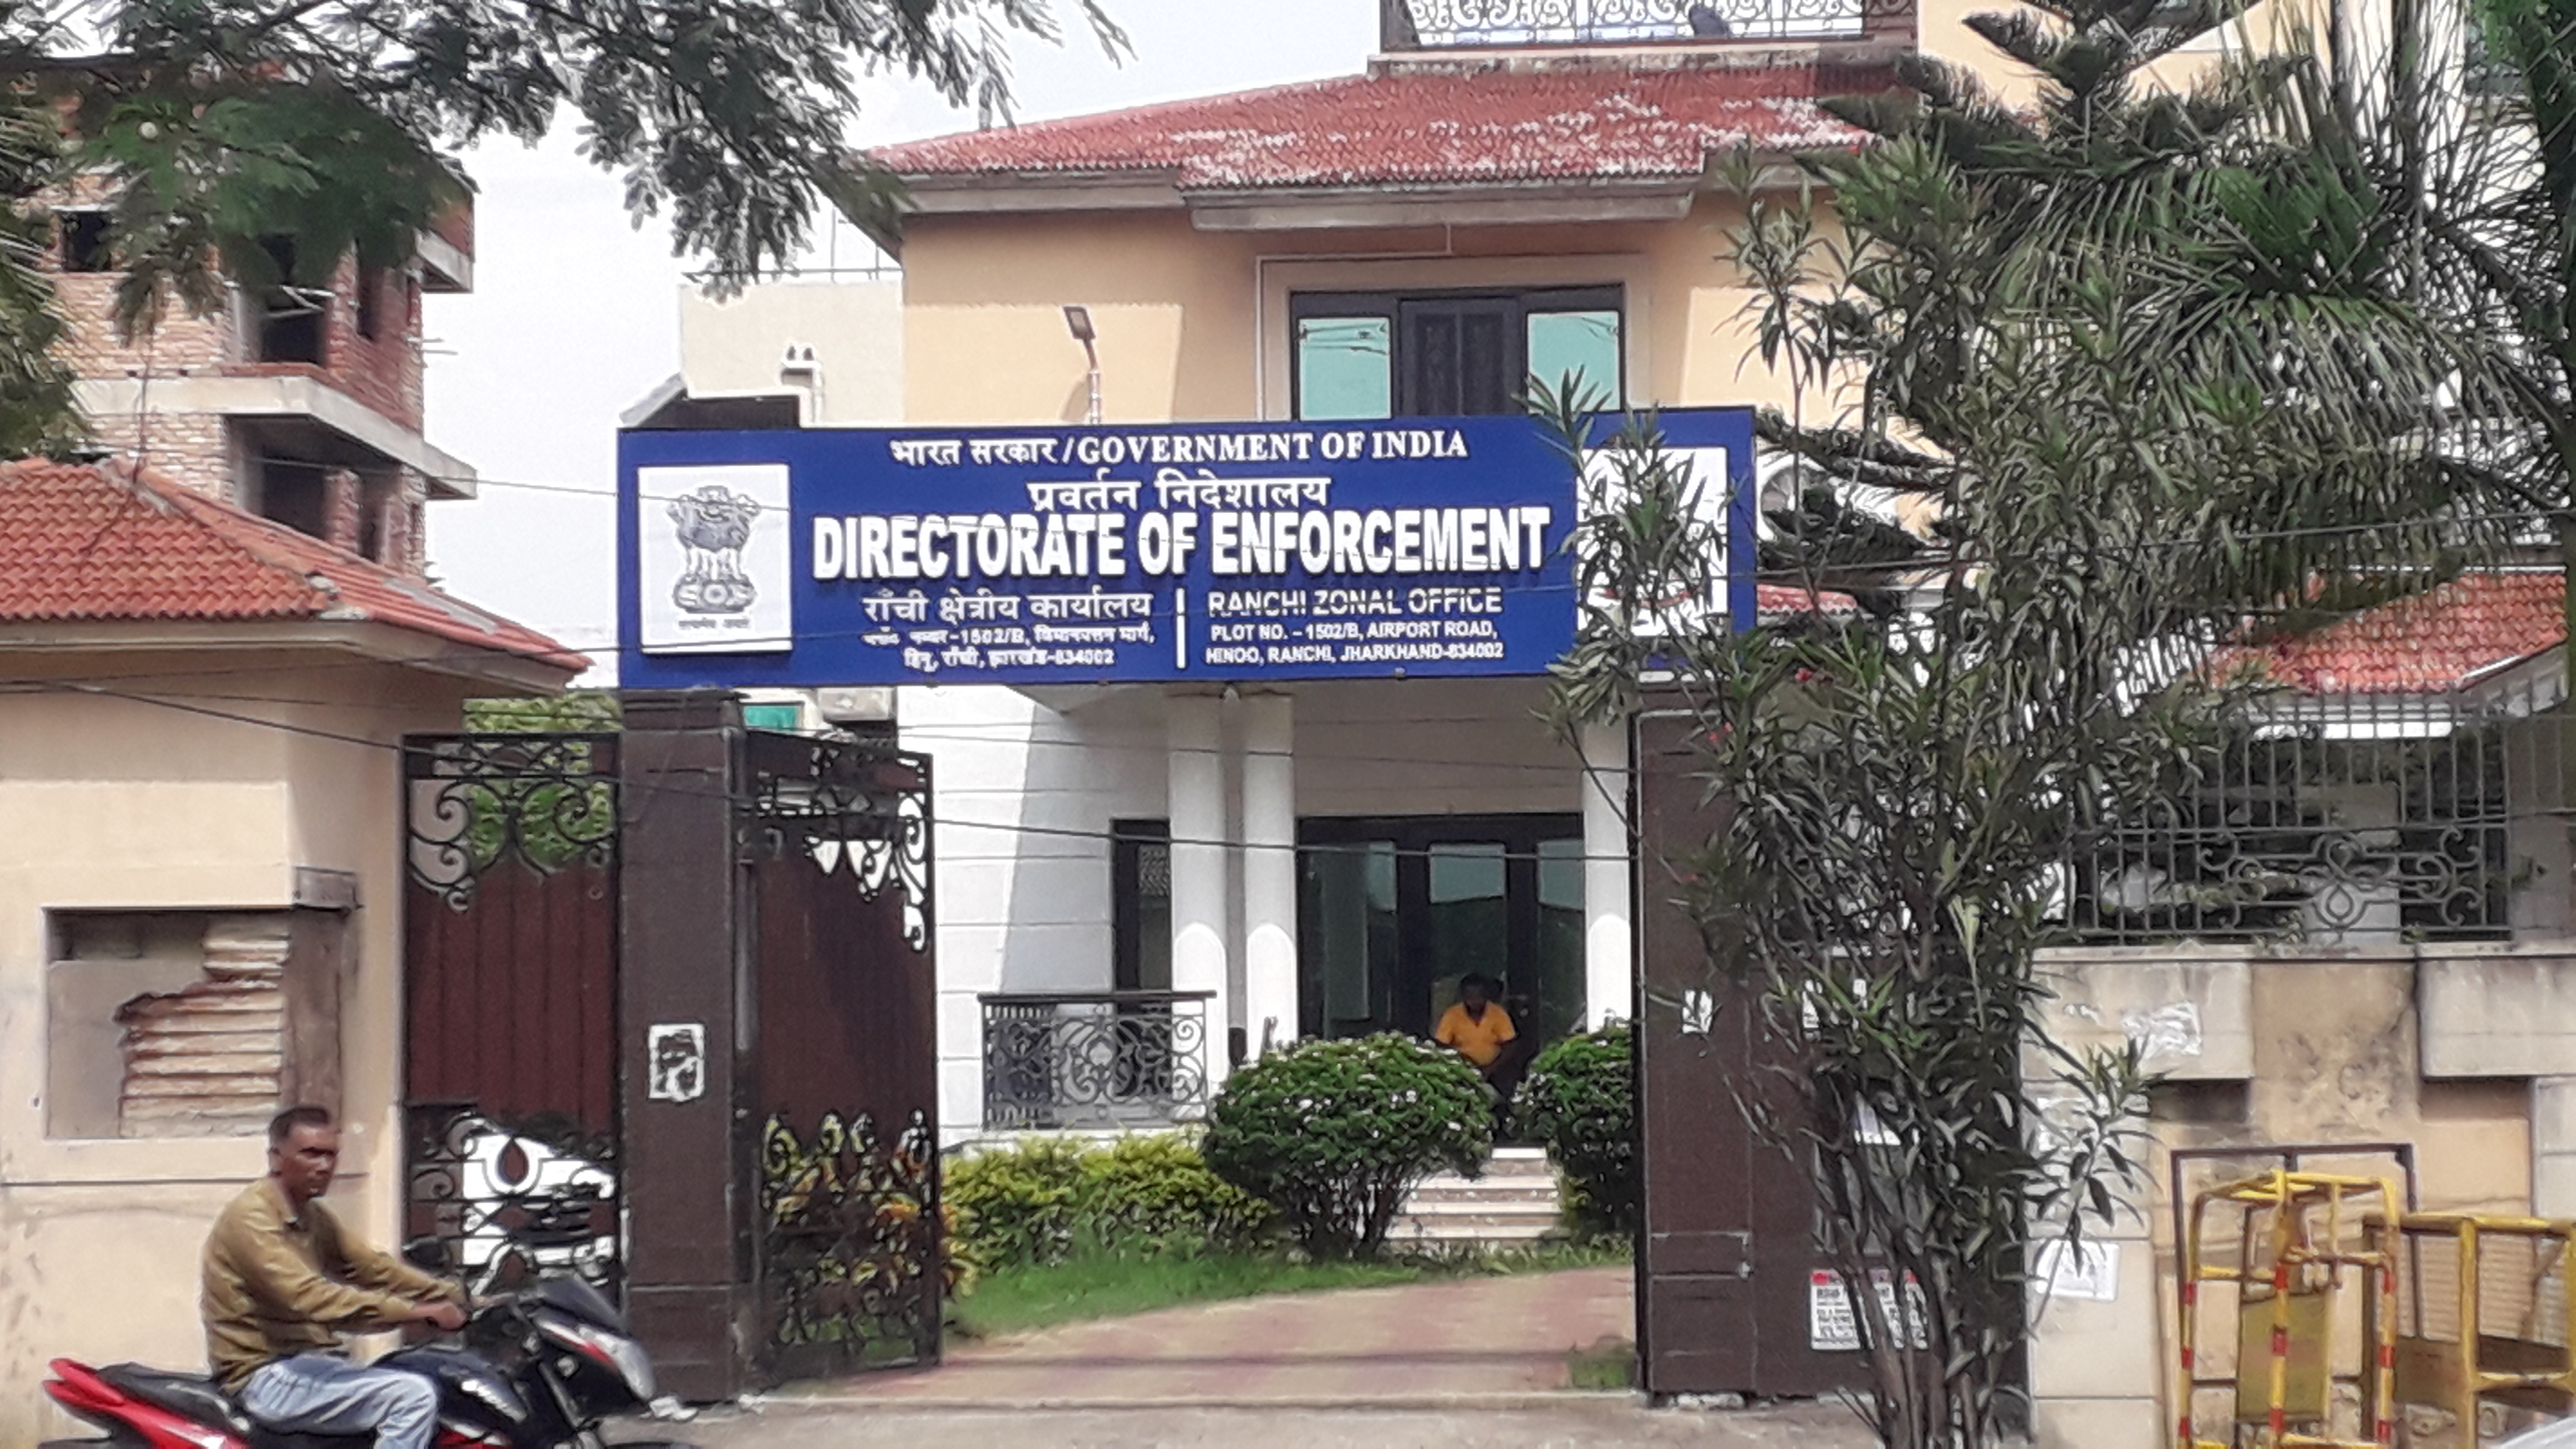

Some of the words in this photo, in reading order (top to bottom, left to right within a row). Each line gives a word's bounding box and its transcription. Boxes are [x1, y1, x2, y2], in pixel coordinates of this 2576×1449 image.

[889, 439, 963, 466] भारत
[1320, 431, 1366, 460] OF
[1371, 429, 1468, 459] INDIA
[1026, 467, 1143, 512] प्रवर्तन
[1154, 467, 1332, 509] निदेशालय
[812, 512, 1126, 579] DIRECTORATE
[1137, 511, 1198, 575] OF
[1211, 506, 1551, 575] ENFORCEMENT
[939, 587, 1022, 625] क्षेत्रीय
[1027, 584, 1154, 618] कार्यालय
[1208, 590, 1307, 618] RANCHI
[1312, 588, 1403, 616] ZONAL
[1408, 587, 1503, 615] OFFICE
[1211, 623, 1256, 642] PLOT
[1257, 623, 1289, 640] NO.
[1305, 622, 1365, 642] 1502/B,
[1367, 620, 1442, 639] AIRPORT
[1443, 619, 1498, 640] ROAD,
[1205, 645, 1265, 666] HINOO,
[1267, 644, 1337, 664] RANCHI,
[1339, 641, 1505, 663] JHARKHAND-834002
